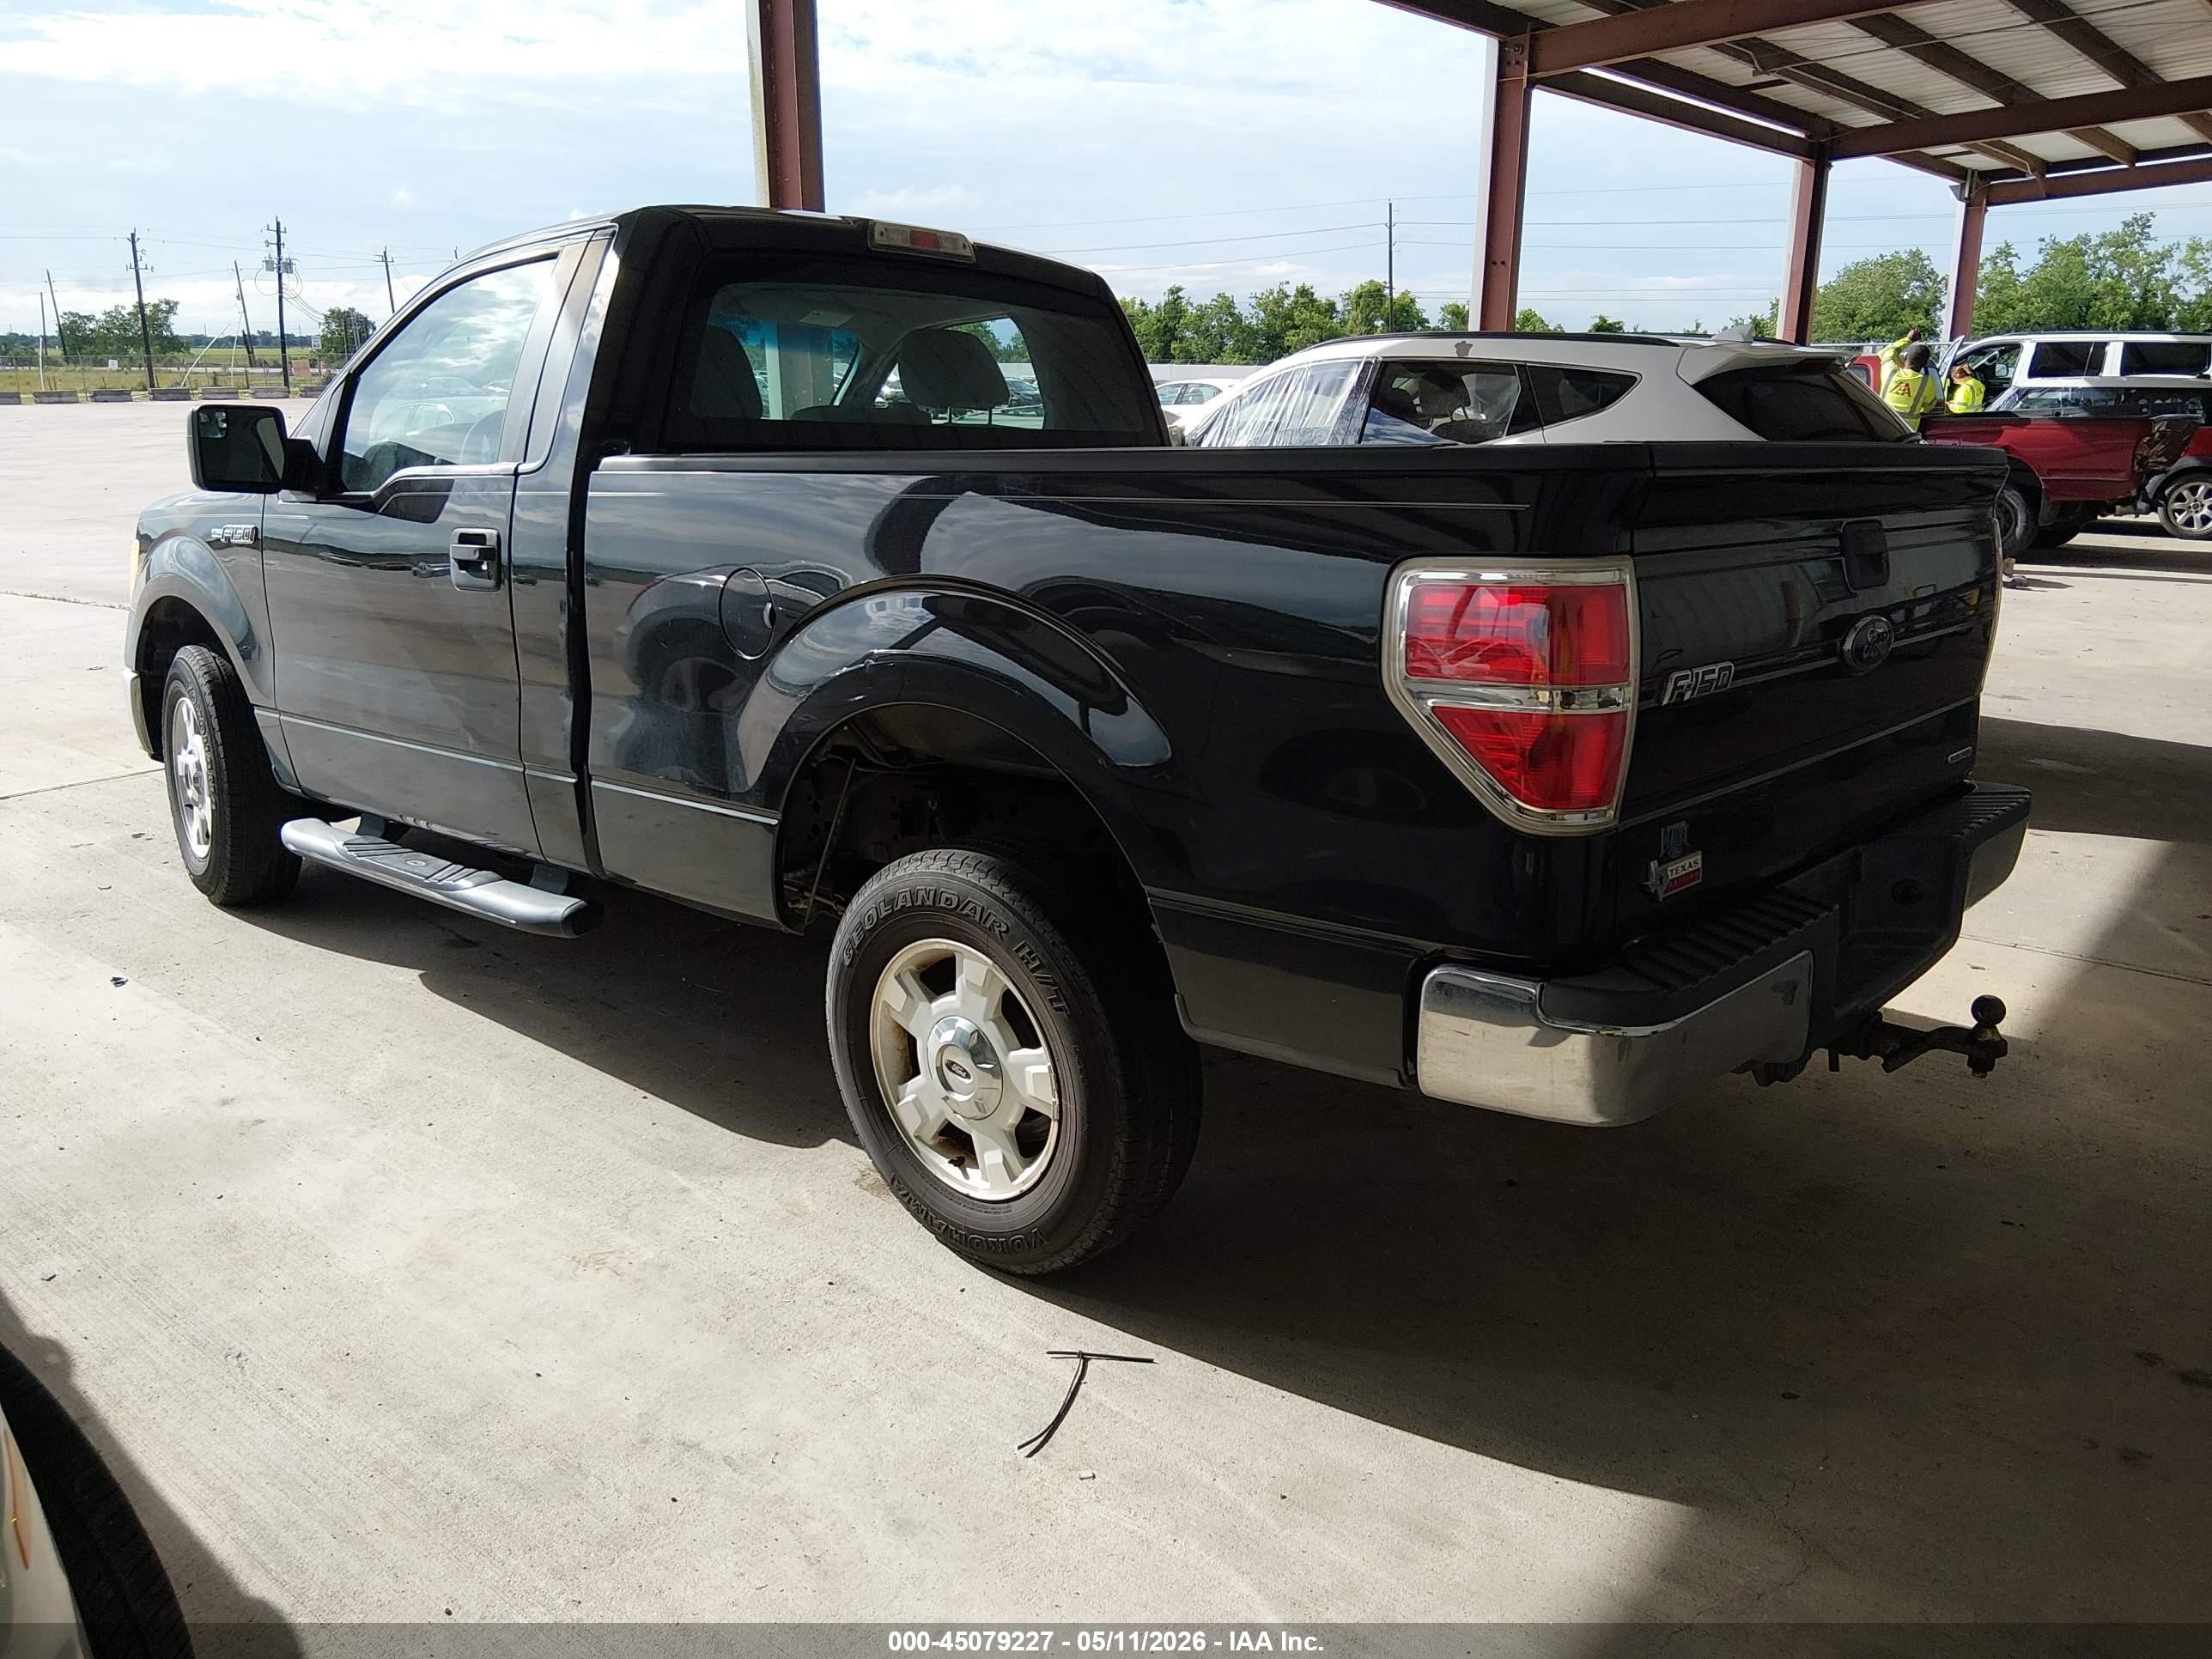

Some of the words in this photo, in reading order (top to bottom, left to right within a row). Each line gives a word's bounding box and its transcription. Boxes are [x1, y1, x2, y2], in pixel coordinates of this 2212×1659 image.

[1668, 859, 1699, 877] TEXAS
[842, 885, 1010, 967] GEOLANDAR
[890, 1173, 1049, 1254] YOKOHAMA
